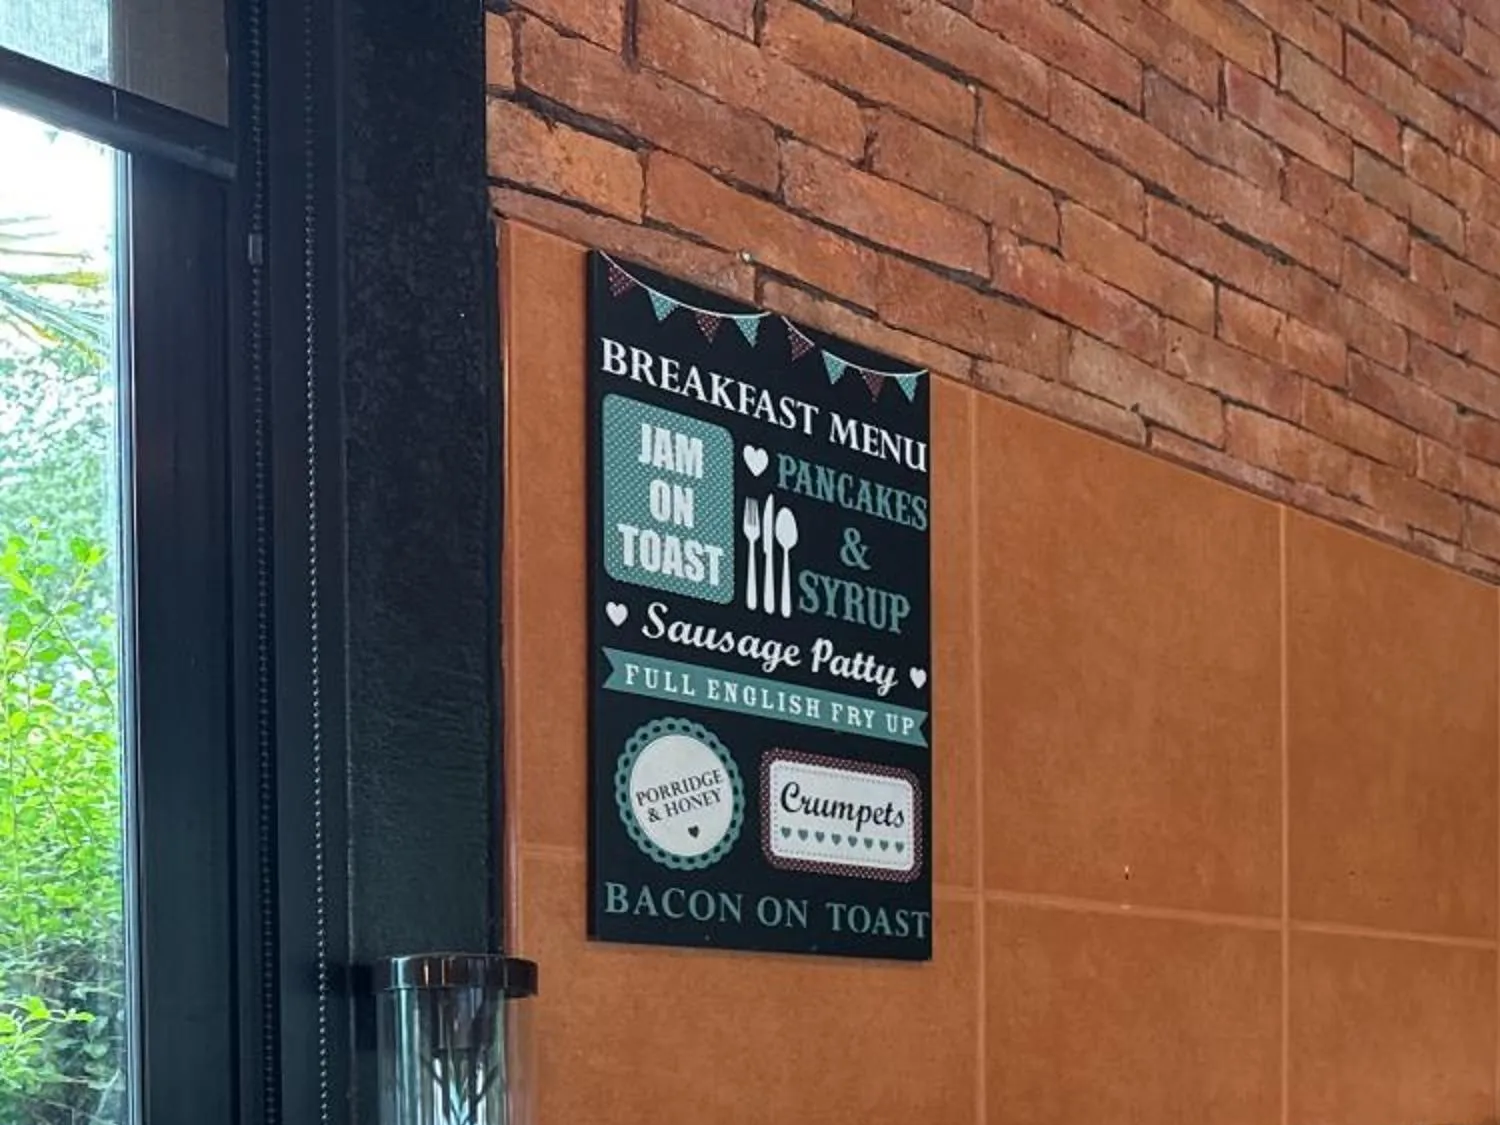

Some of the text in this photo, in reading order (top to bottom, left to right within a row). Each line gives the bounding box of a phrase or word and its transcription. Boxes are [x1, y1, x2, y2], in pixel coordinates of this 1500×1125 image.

[601, 337, 928, 473] BREAKFAST MENU
[638, 423, 702, 479] JAM
[650, 479, 694, 529] ON
[776, 453, 928, 532] PANCAKES
[617, 523, 724, 587] TOAST
[840, 527, 872, 570] &
[799, 570, 911, 634] SYRUP
[641, 602, 899, 697] Sausage Patty
[624, 663, 915, 737] FULL ENGLISH FRY UP
[635, 769, 724, 807] PORRIDGE
[647, 787, 721, 823] & HONEY
[780, 781, 906, 832] Crumpets
[604, 881, 930, 940] BACON ON TOAST
